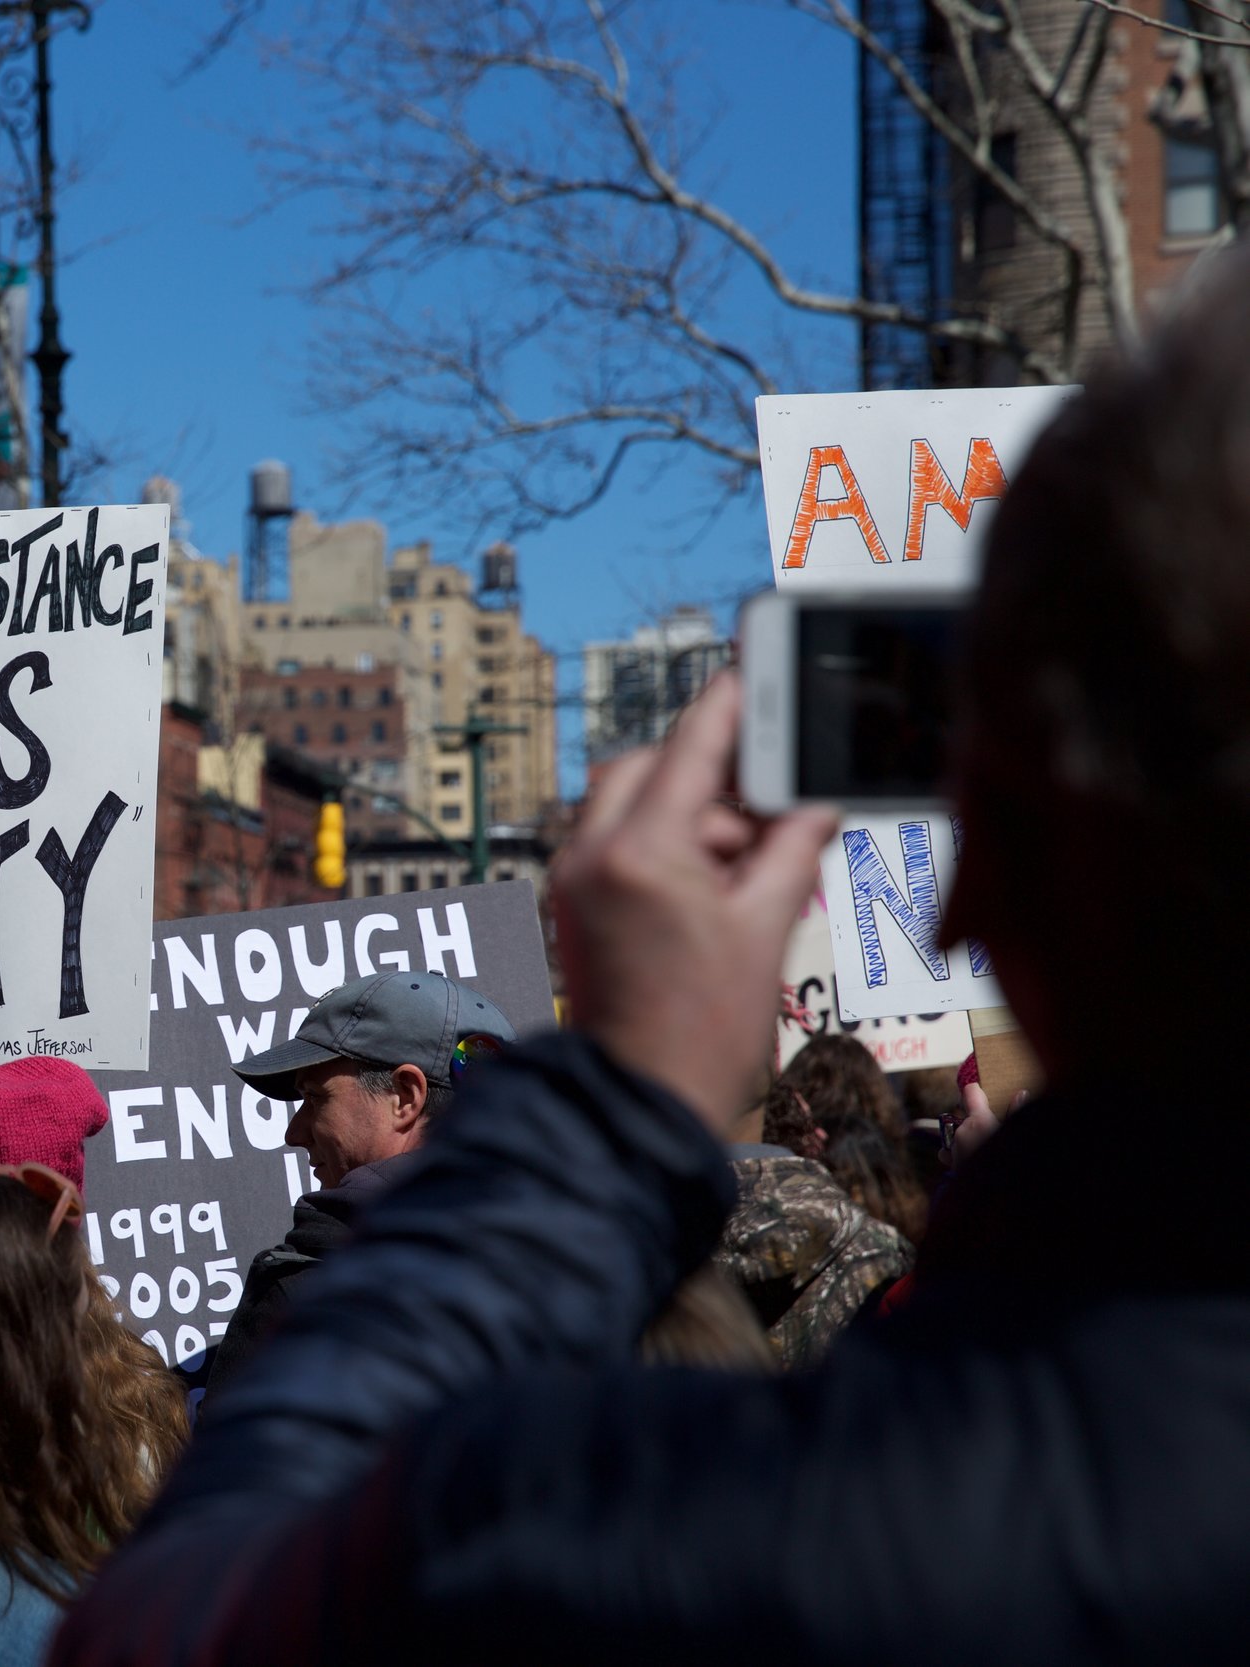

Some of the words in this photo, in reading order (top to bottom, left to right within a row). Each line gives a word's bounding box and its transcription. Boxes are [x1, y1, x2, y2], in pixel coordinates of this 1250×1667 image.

[150, 902, 478, 1010] NOUGH
[27, 1028, 93, 1056] JEFFERSON
[108, 1084, 305, 1163] ENO
[283, 1152, 323, 1207] I
[86, 1201, 227, 1265] 1999
